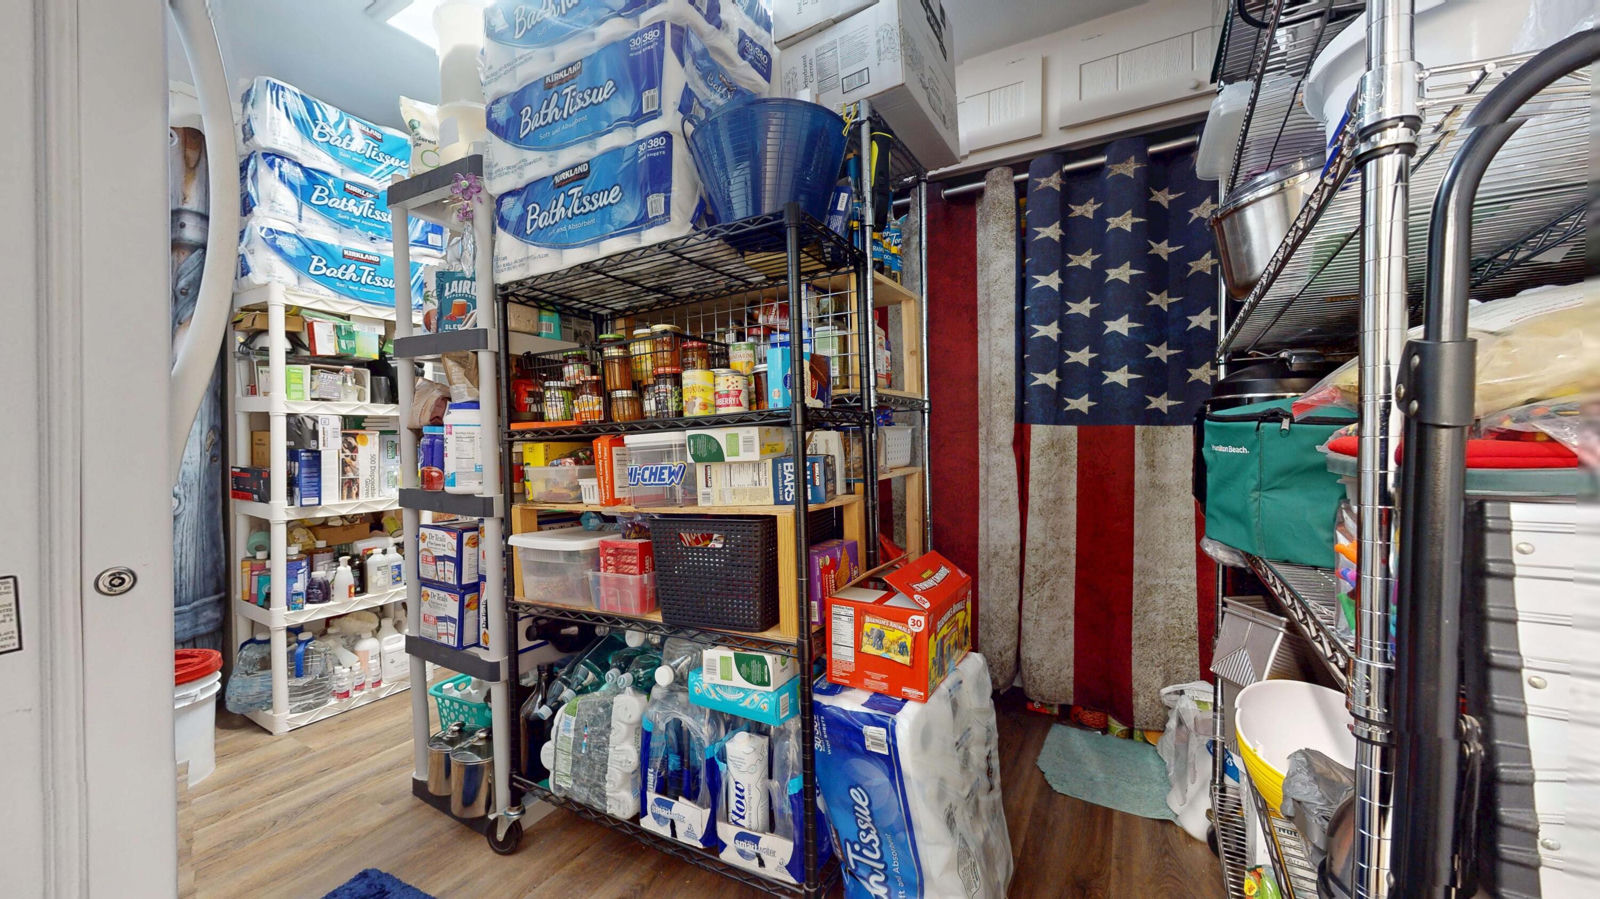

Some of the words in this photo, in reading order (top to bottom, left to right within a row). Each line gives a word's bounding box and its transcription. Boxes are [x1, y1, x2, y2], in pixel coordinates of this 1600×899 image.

[629, 37, 641, 48] 30
[642, 29, 660, 43] 380
[545, 61, 582, 85] KIRKLAND
[519, 91, 563, 139] Bath
[560, 80, 617, 119] Tissue
[648, 136, 667, 149] 380
[309, 184, 362, 217] Bath
[525, 193, 568, 235] Bath
[566, 184, 623, 219] Tissue
[308, 254, 359, 282] Bath
[358, 265, 395, 289] Tissu
[343, 250, 380, 263] KIRKLAND
[783, 462, 795, 502] BARS
[910, 618, 922, 628] 30
[846, 786, 886, 870] Tissue
